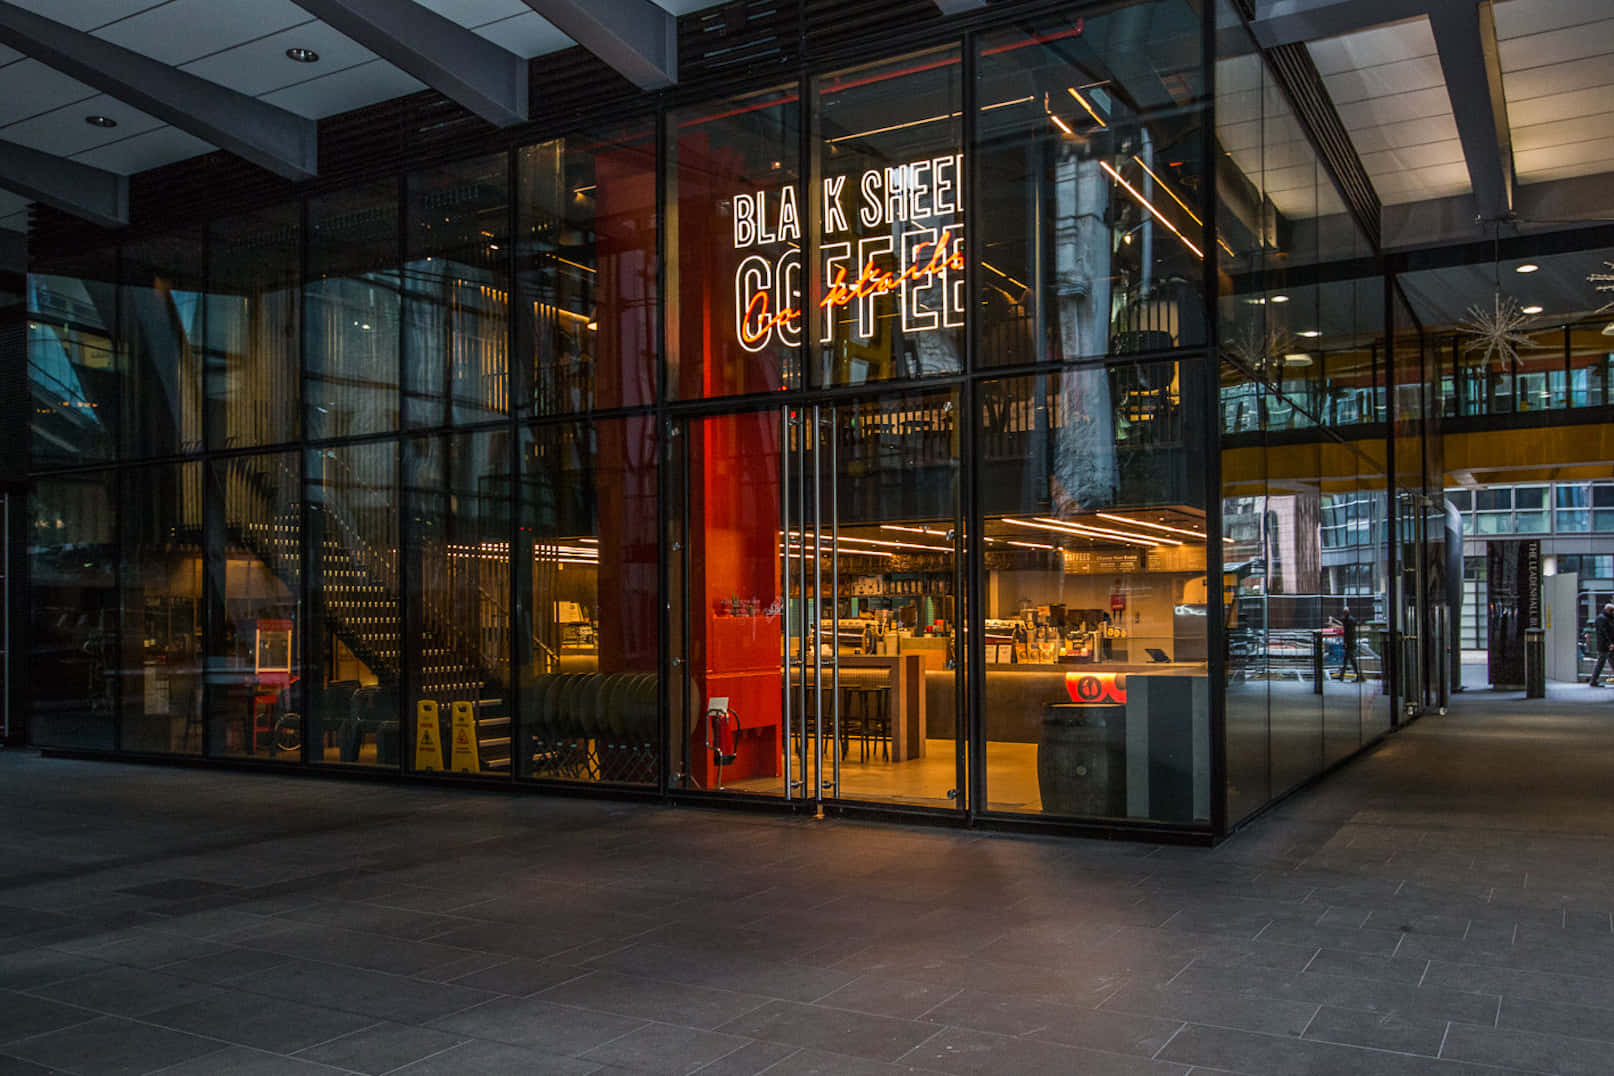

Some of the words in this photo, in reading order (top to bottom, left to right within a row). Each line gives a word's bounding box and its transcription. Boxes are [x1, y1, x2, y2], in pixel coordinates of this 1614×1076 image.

[733, 175, 849, 249] BLAK
[860, 153, 965, 228] SHEE
[741, 230, 965, 344] Coktails
